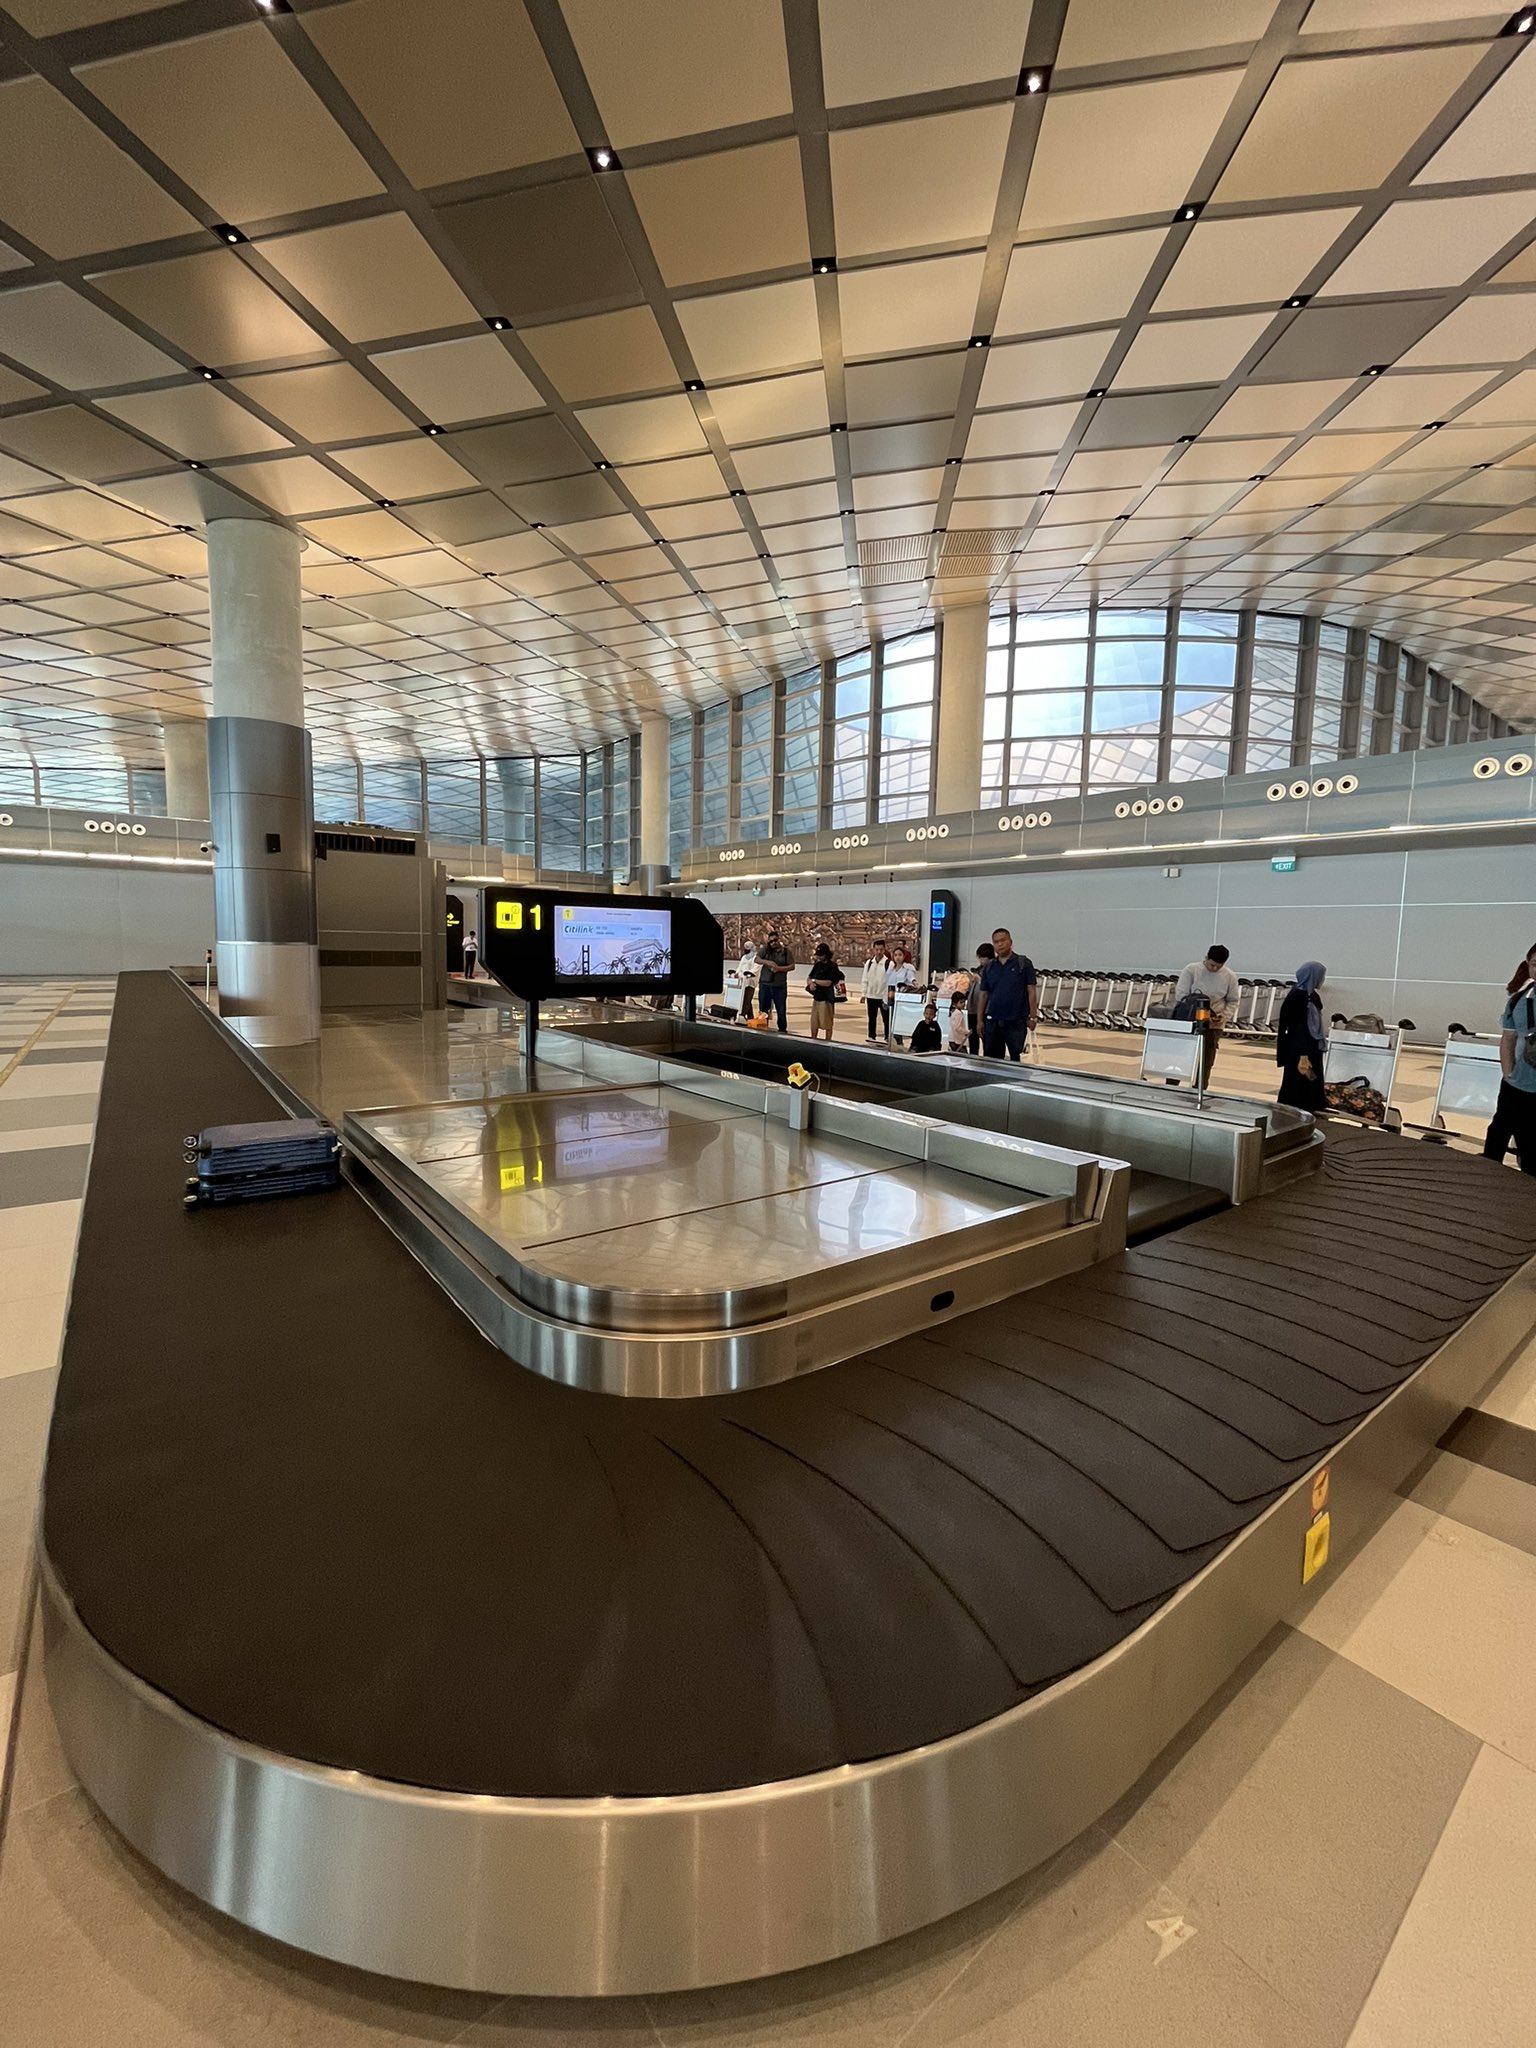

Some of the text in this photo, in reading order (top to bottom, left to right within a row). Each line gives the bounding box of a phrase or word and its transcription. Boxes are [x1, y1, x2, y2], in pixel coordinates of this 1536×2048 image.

[1279, 862, 1292, 870] EXIT
[530, 904, 541, 930] 1
[564, 925, 594, 934] Citilink
